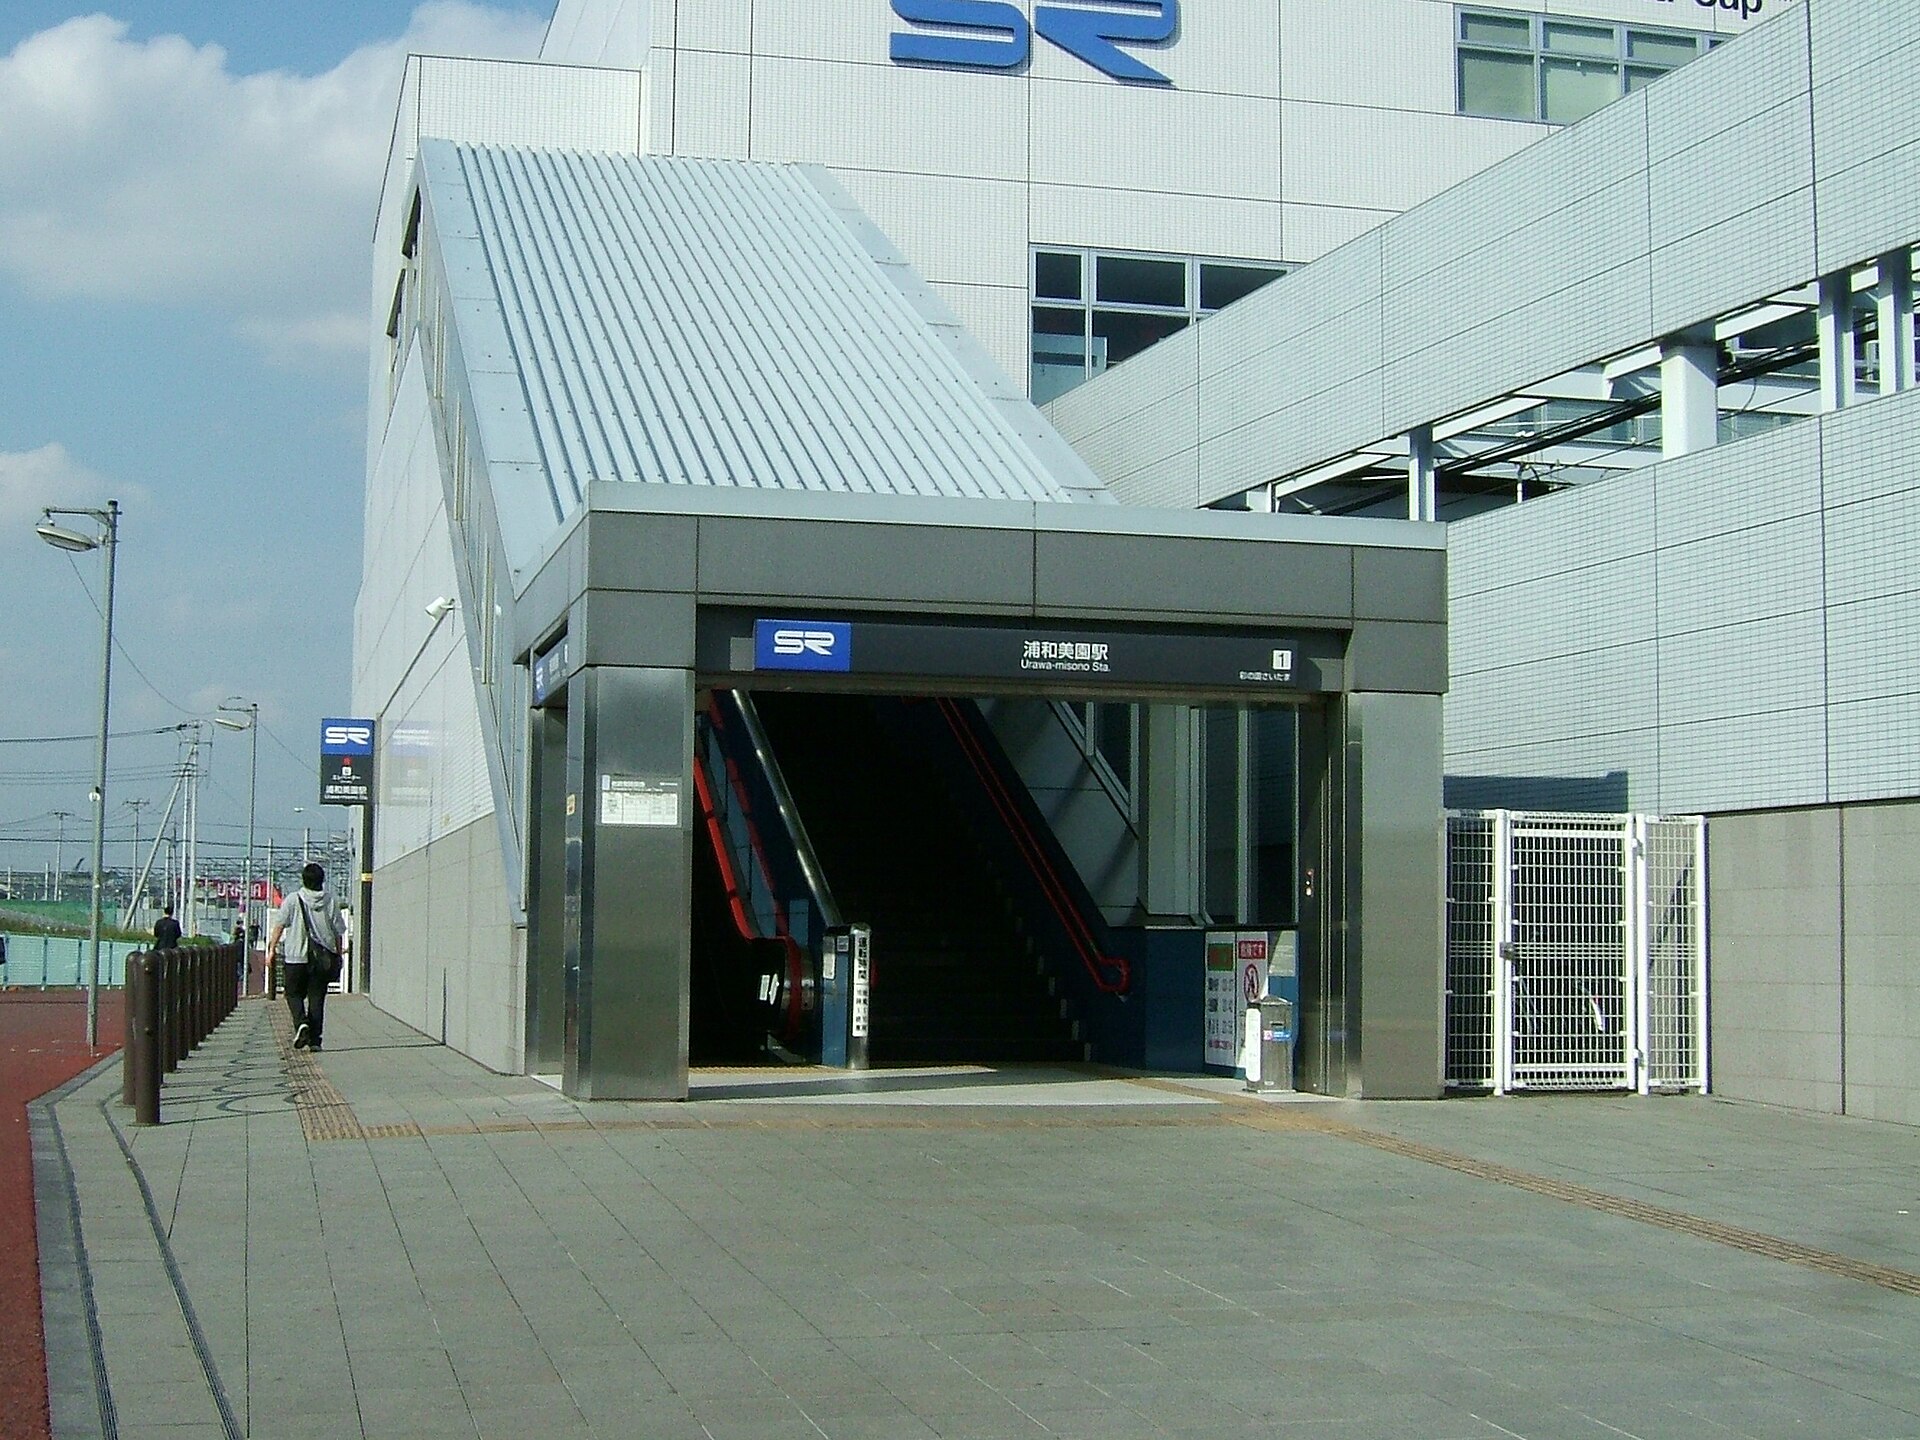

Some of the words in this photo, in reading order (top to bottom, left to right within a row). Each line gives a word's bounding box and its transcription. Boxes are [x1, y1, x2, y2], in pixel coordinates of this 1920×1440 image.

[889, 0, 1179, 86] SR
[774, 630, 835, 656] SR
[1023, 640, 1109, 661] 浦和美園駅
[1020, 659, 1090, 671] Urawa-misono
[1092, 661, 1112, 673] Sta.
[1278, 652, 1285, 668] 1
[325, 726, 370, 745] SR
